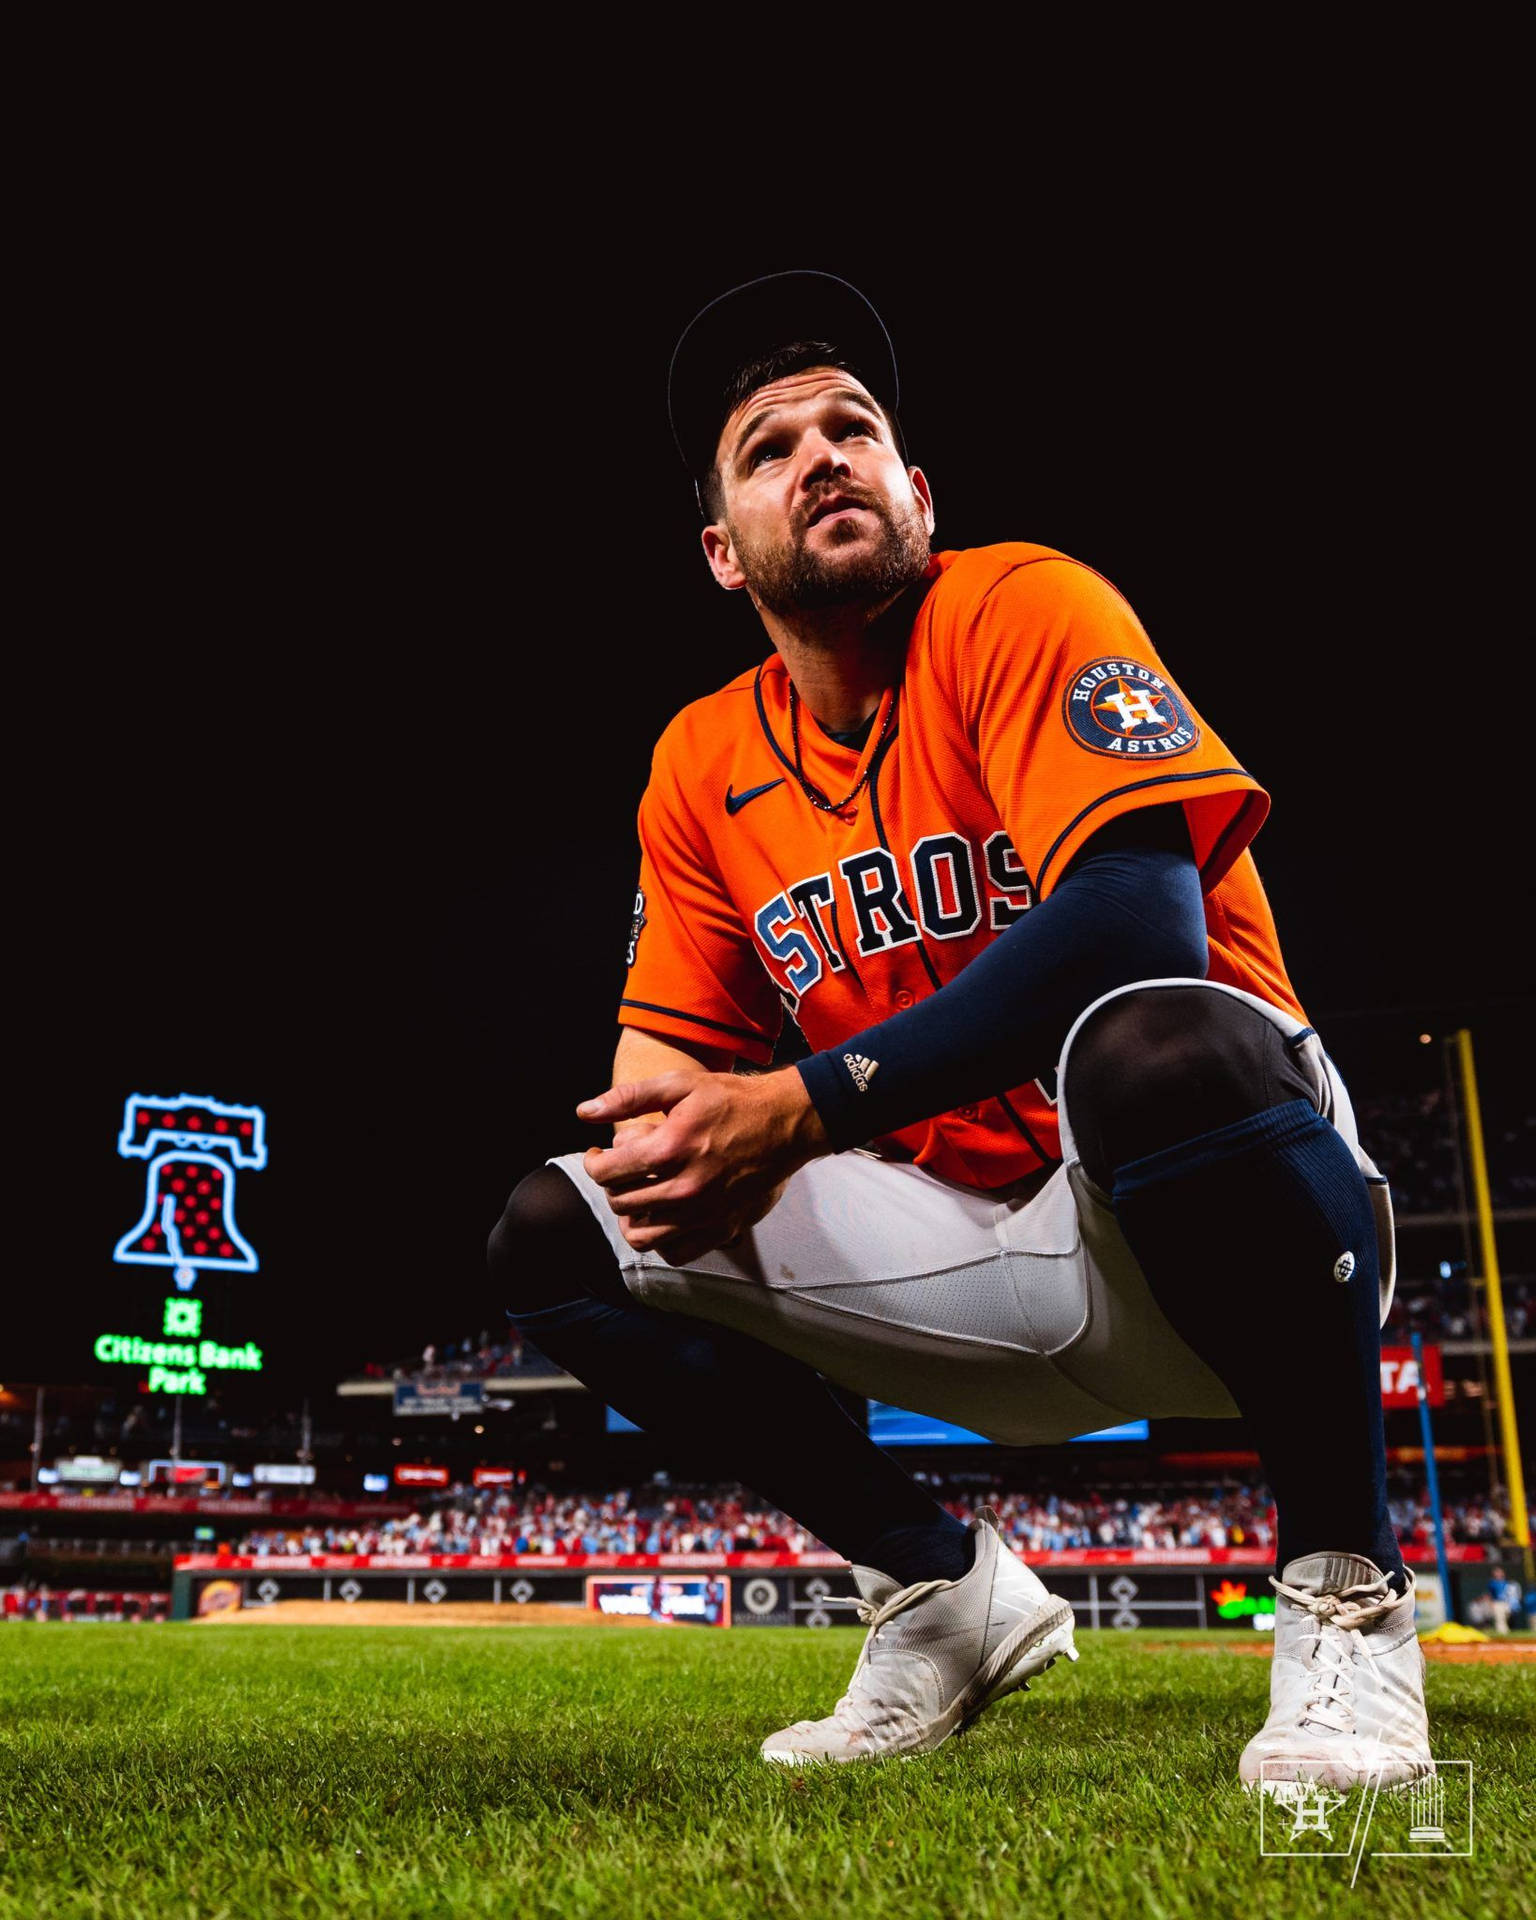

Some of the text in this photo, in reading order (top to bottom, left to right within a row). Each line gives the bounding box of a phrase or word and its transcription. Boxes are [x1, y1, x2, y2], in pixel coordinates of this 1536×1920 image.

[1073, 663, 1165, 701] HOUSTON
[1104, 689, 1167, 729] H
[1108, 726, 1193, 753] ASTROS
[754, 830, 1034, 1015] STROS
[843, 1053, 868, 1092] adidas
[94, 1335, 263, 1371] Citizens Bank
[149, 1365, 206, 1395] Park
